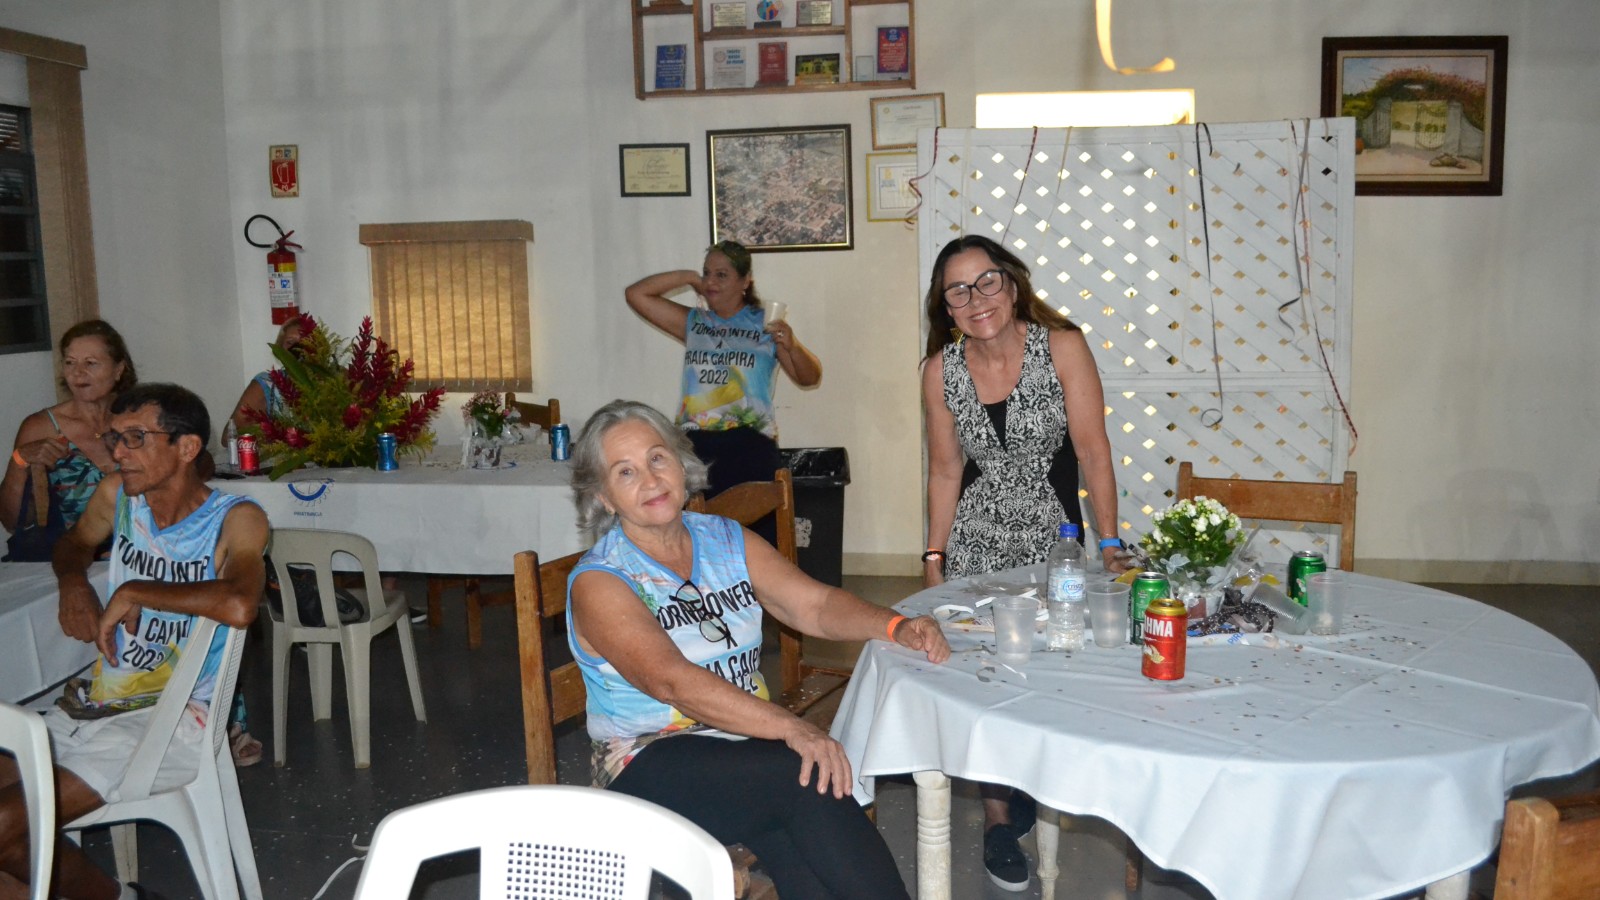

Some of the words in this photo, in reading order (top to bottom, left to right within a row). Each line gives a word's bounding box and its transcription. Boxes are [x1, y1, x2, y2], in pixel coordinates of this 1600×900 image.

[729, 327, 760, 342] INTER
[711, 351, 755, 368] CAIPIRA
[699, 369, 729, 385] 2022
